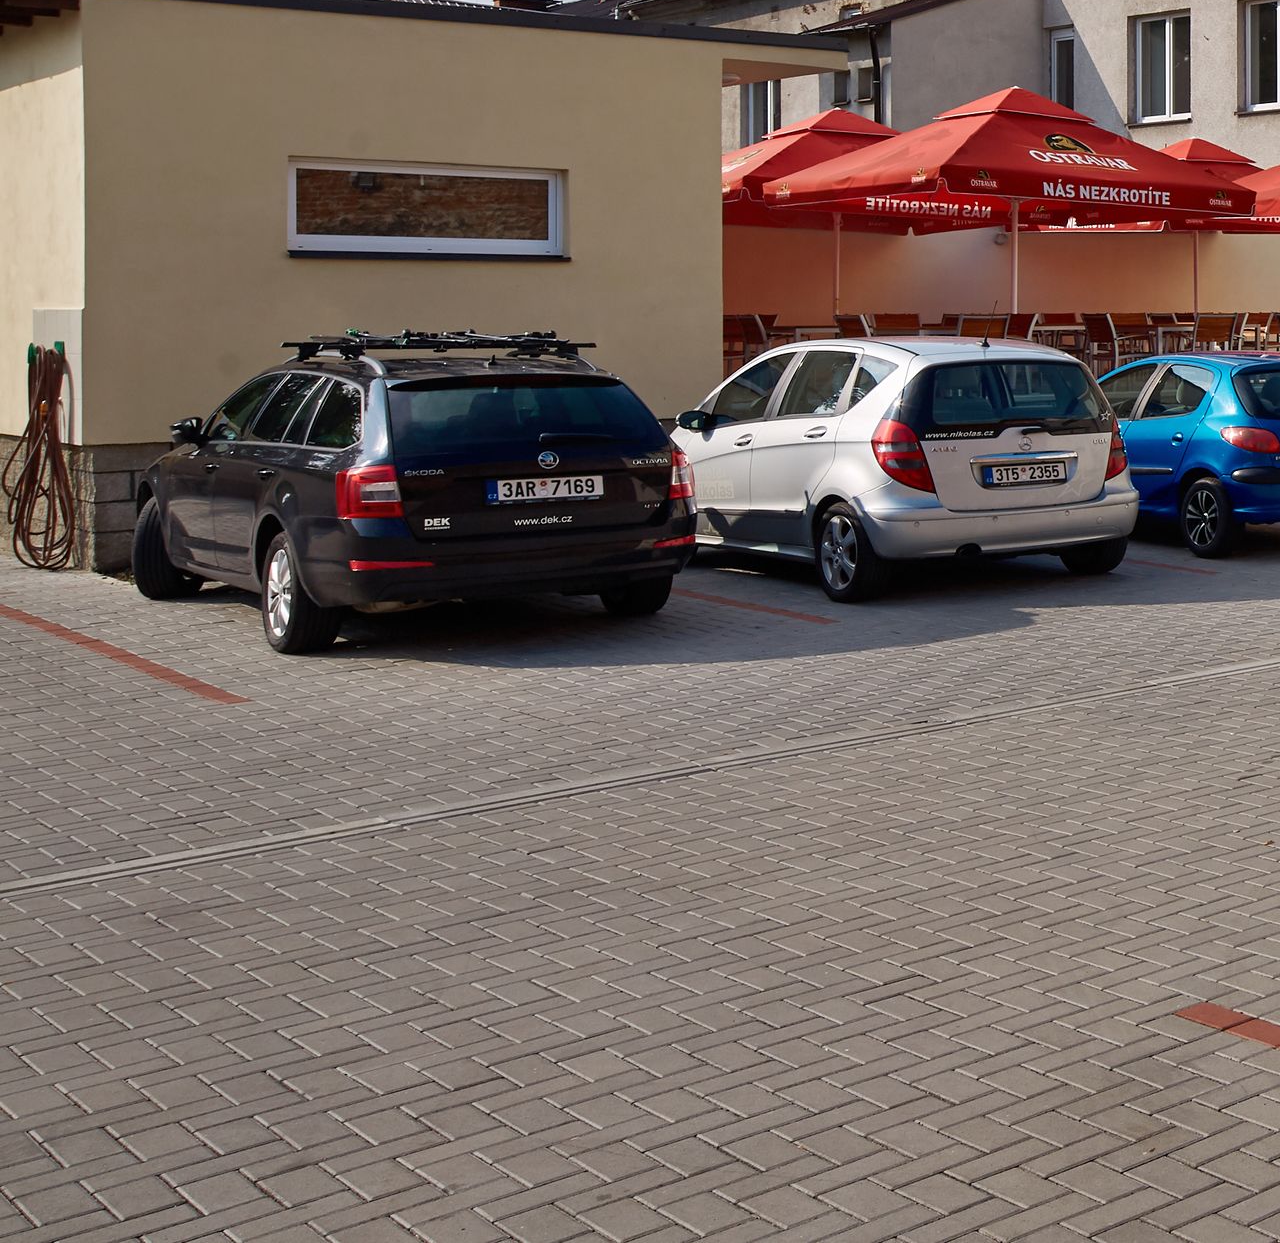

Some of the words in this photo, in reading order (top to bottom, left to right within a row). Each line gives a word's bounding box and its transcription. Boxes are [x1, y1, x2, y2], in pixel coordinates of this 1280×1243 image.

[1029, 150, 1138, 171] OSTRAVAR
[1043, 179, 1075, 198] NÁS
[1079, 186, 1170, 205] NEZKROTÍTE
[925, 429, 995, 439] www.nikolas.cz
[632, 457, 668, 465] OCTAVIA
[996, 467, 1020, 482] 3T5
[1028, 465, 1060, 480] 2355
[502, 480, 537, 498] 3AR
[550, 478, 595, 496] 7169
[424, 517, 451, 527] DEK
[514, 515, 573, 526] www.dek.cz
